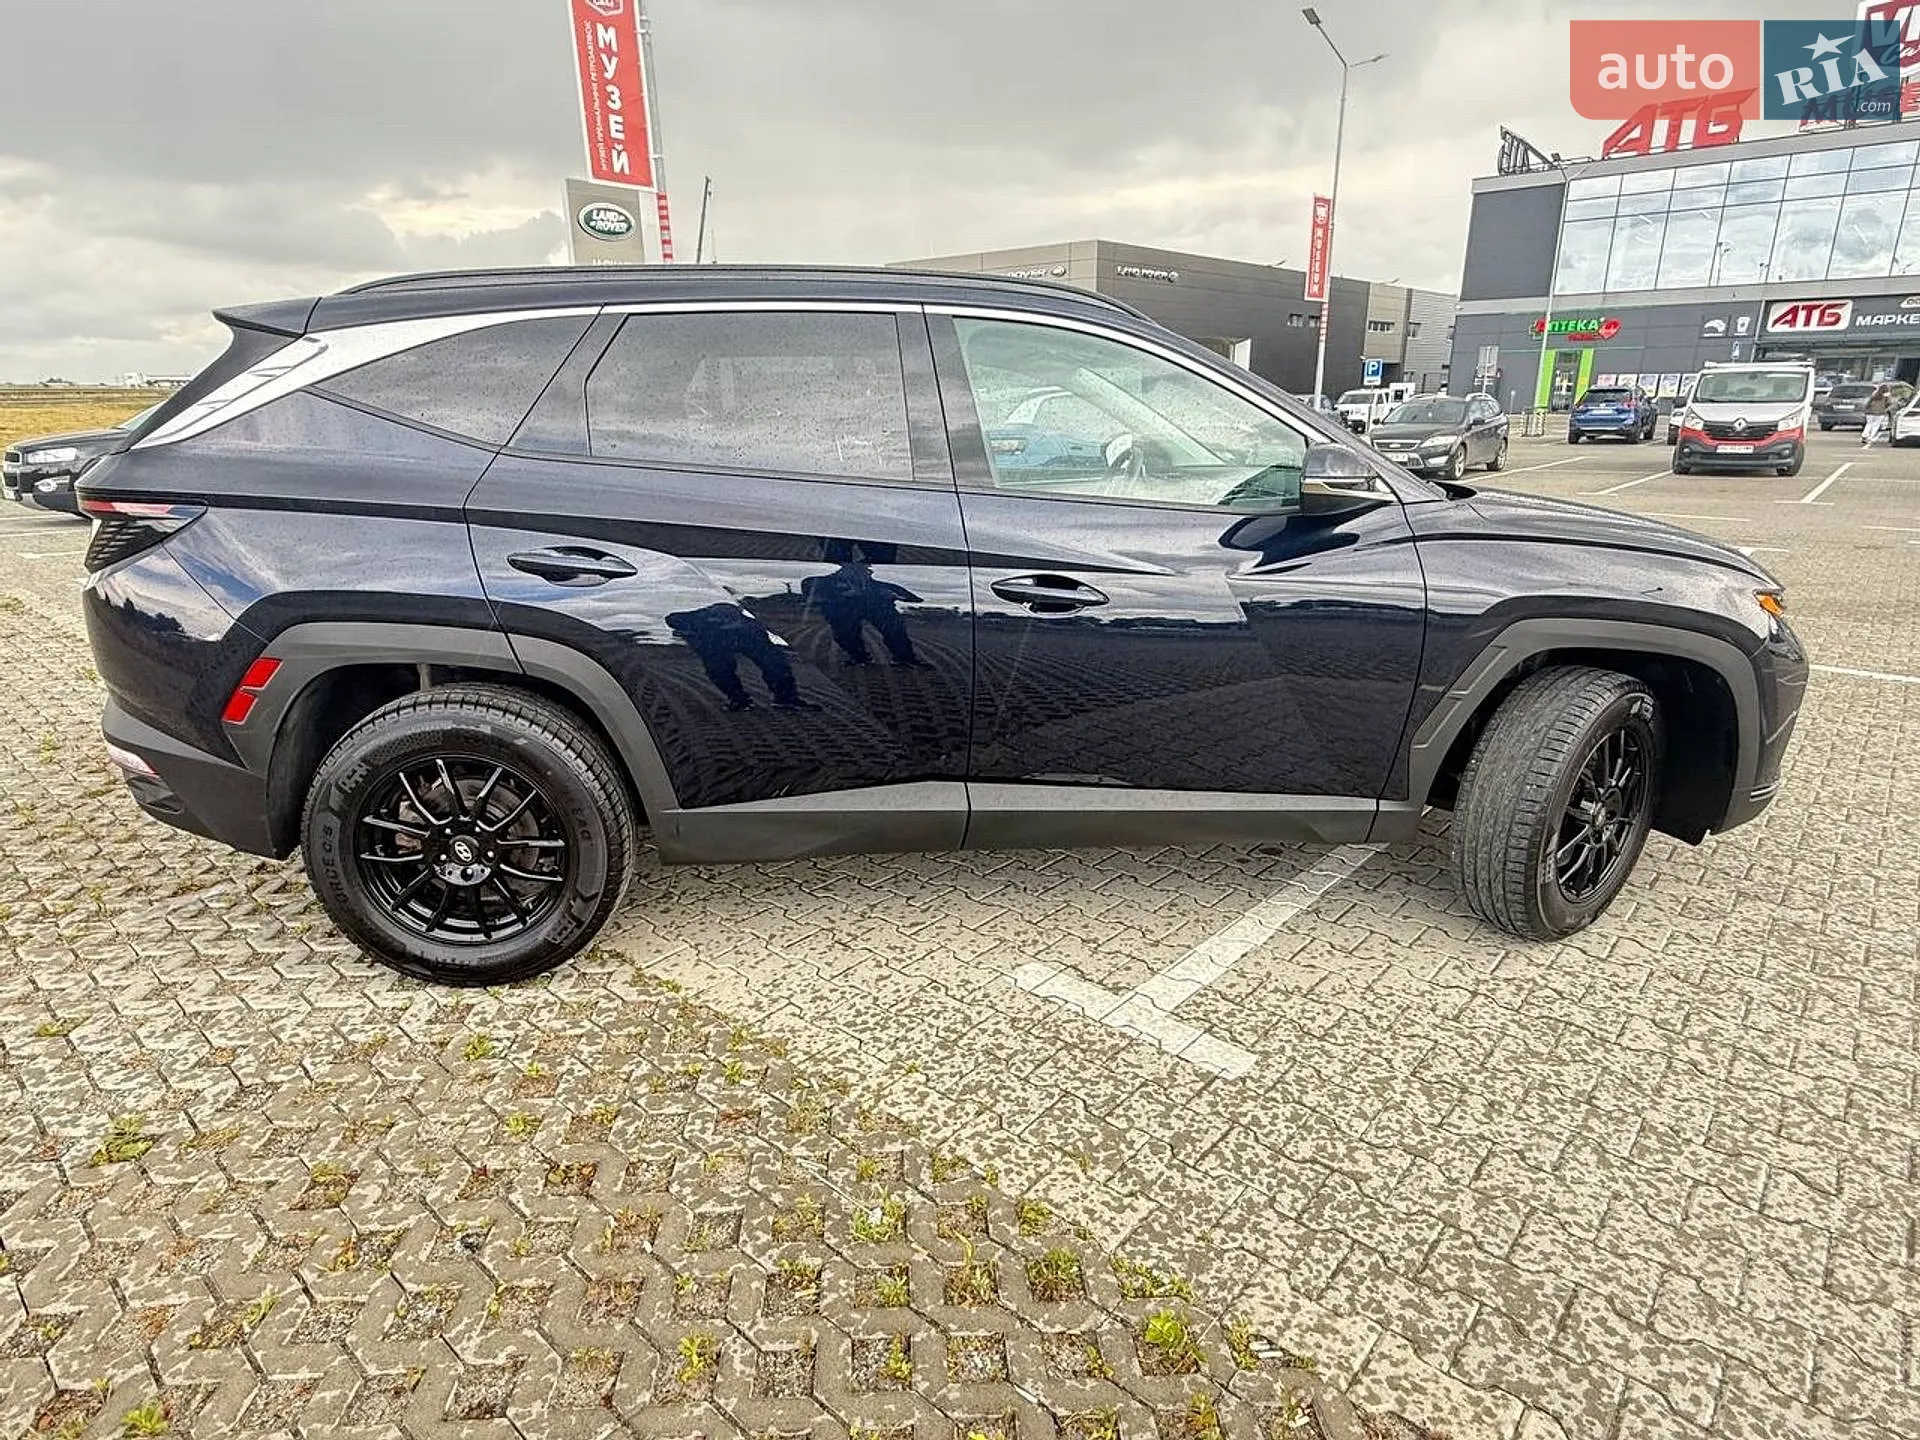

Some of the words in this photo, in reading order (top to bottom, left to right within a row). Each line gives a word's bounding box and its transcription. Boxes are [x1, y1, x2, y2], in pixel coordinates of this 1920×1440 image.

[596, 22, 630, 175] МУЗЕЙ
[1772, 302, 1848, 328] АТБ
[1368, 361, 1378, 375] P
